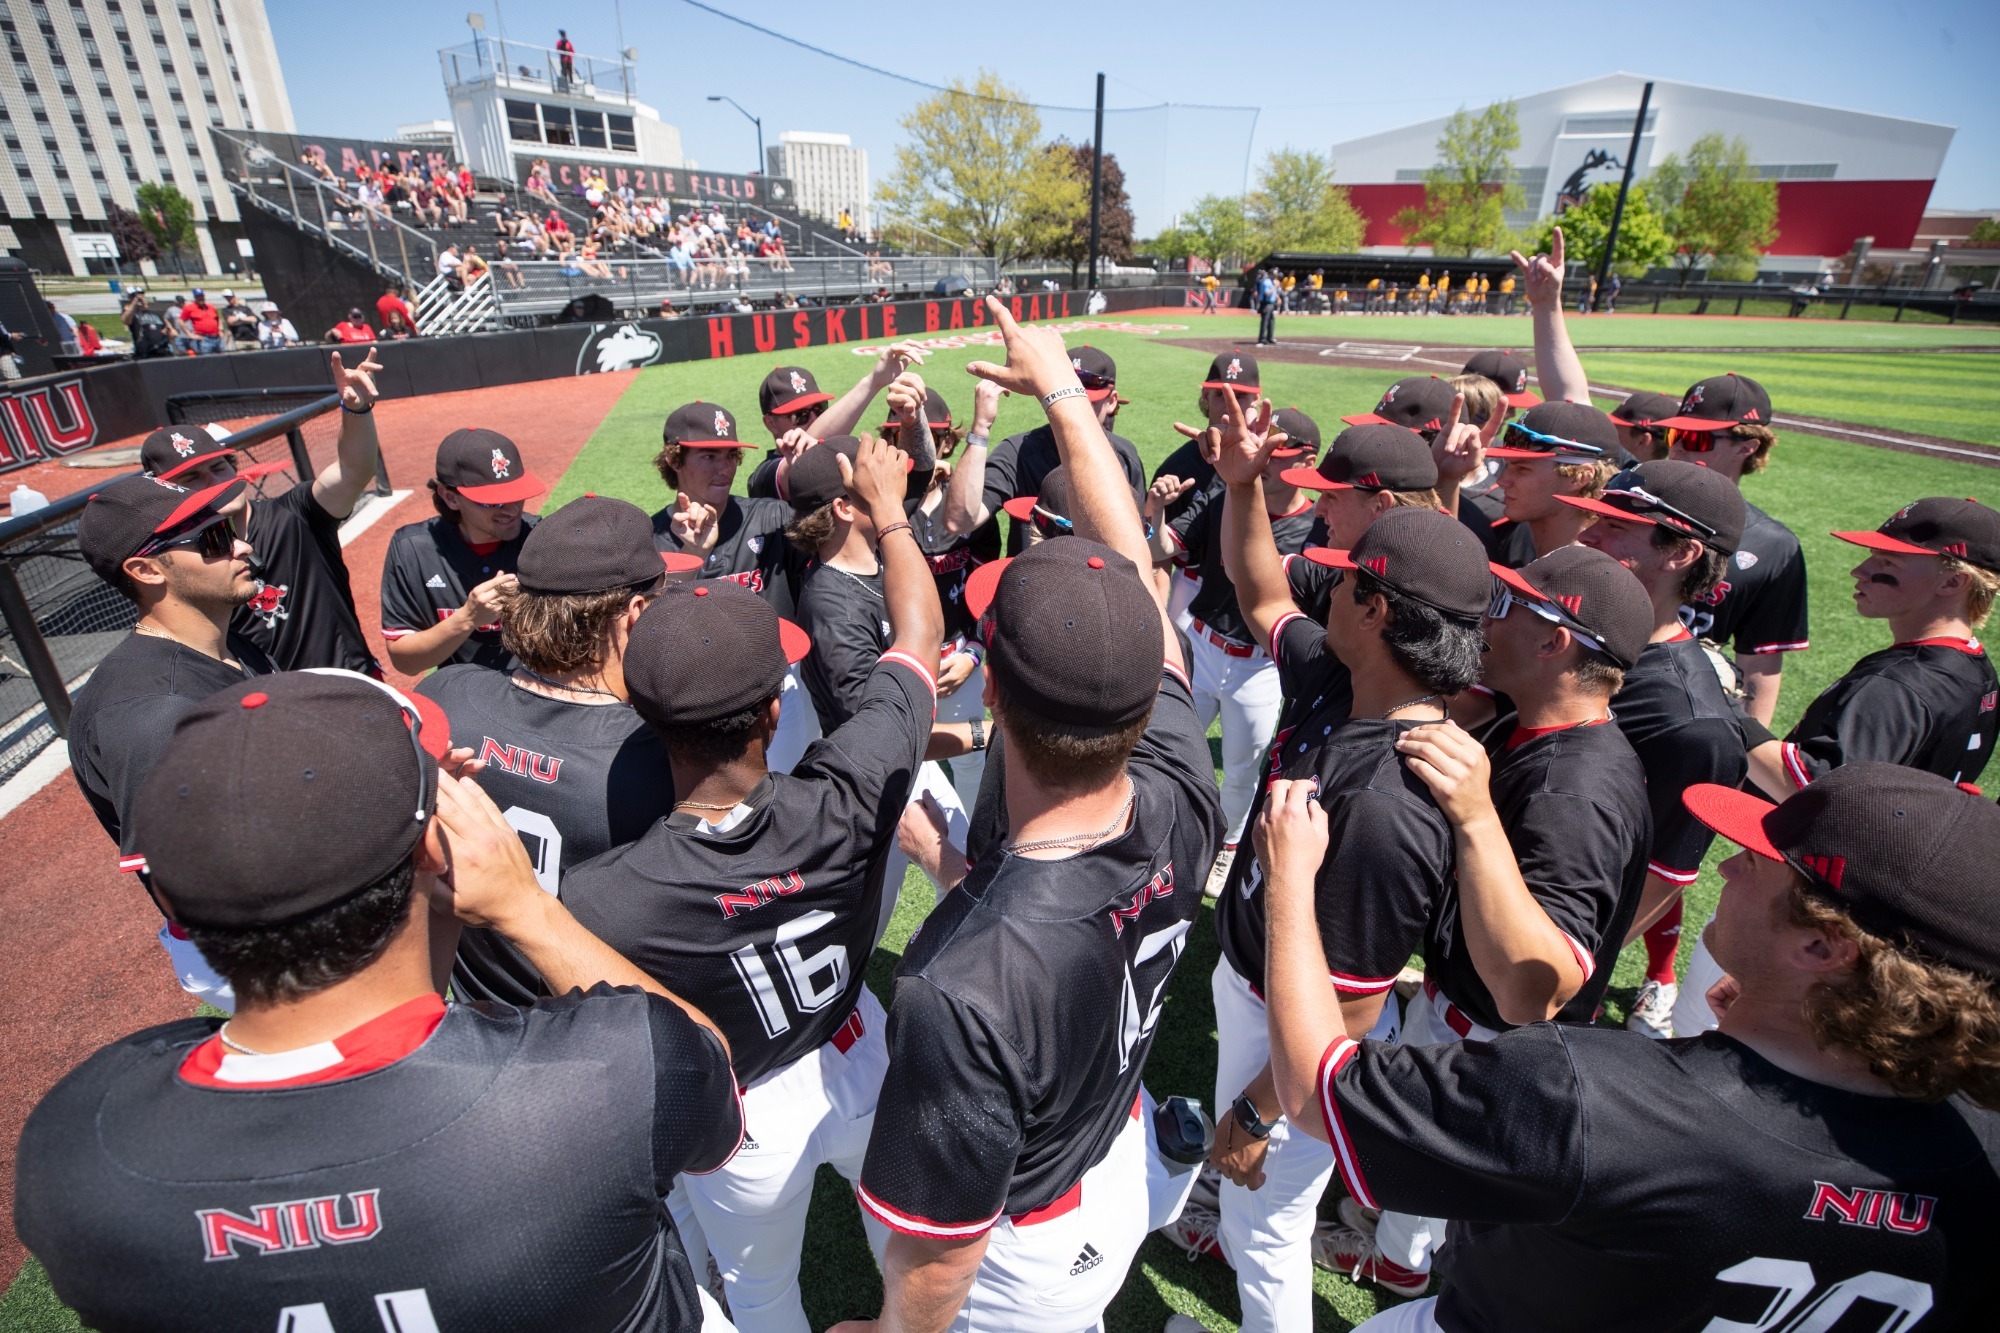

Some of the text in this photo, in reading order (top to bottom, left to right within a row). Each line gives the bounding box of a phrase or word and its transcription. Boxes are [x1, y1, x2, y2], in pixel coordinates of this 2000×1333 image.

[532, 161, 756, 198] CKINZIE FIELD
[1184, 288, 1232, 307] NU
[708, 305, 898, 358] HUSKIE
[925, 292, 1070, 332] BASBALL
[1045, 387, 1088, 403] TRUST GO
[479, 735, 564, 784] NIU
[713, 868, 806, 920] NIU
[1109, 860, 1174, 939] NIU
[728, 909, 851, 1040] 16
[194, 1188, 383, 1262] NIU
[1802, 1180, 1938, 1235] NIU
[1069, 1253, 1104, 1276] adidas
